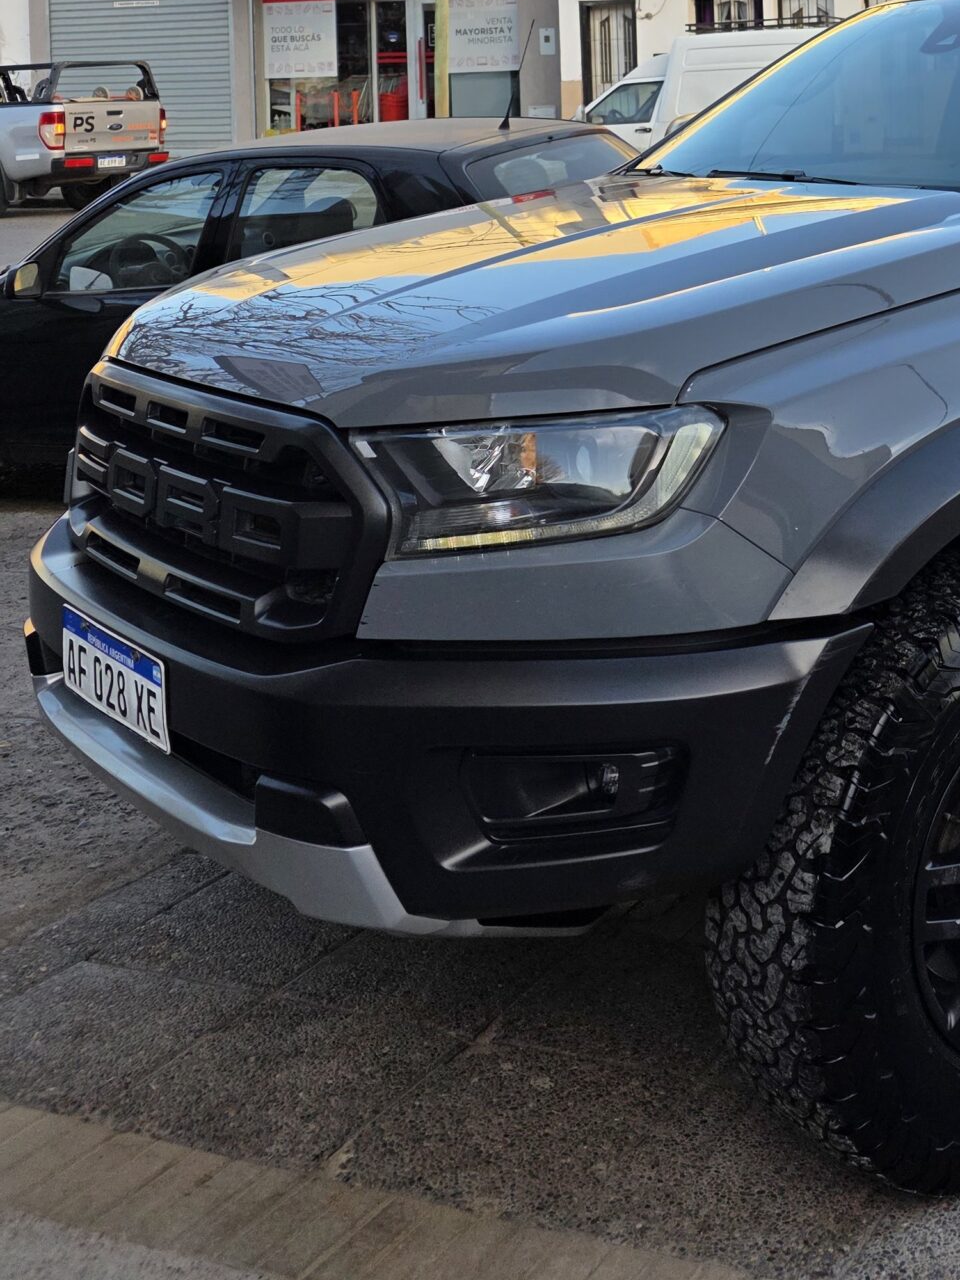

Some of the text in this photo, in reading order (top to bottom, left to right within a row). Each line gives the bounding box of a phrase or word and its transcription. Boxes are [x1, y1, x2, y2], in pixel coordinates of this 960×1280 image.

[485, 16, 513, 25] VENTA
[271, 25, 305, 34] TODO LO
[455, 25, 513, 36] MAYORISTA Y
[271, 34, 289, 43] QUE
[468, 36, 513, 45] MINORISTA
[73, 115, 95, 133] PS
[77, 425, 299, 568] FORD
[109, 646, 135, 670] ARGENTINA
[68, 638, 161, 740] AF 028 XE
